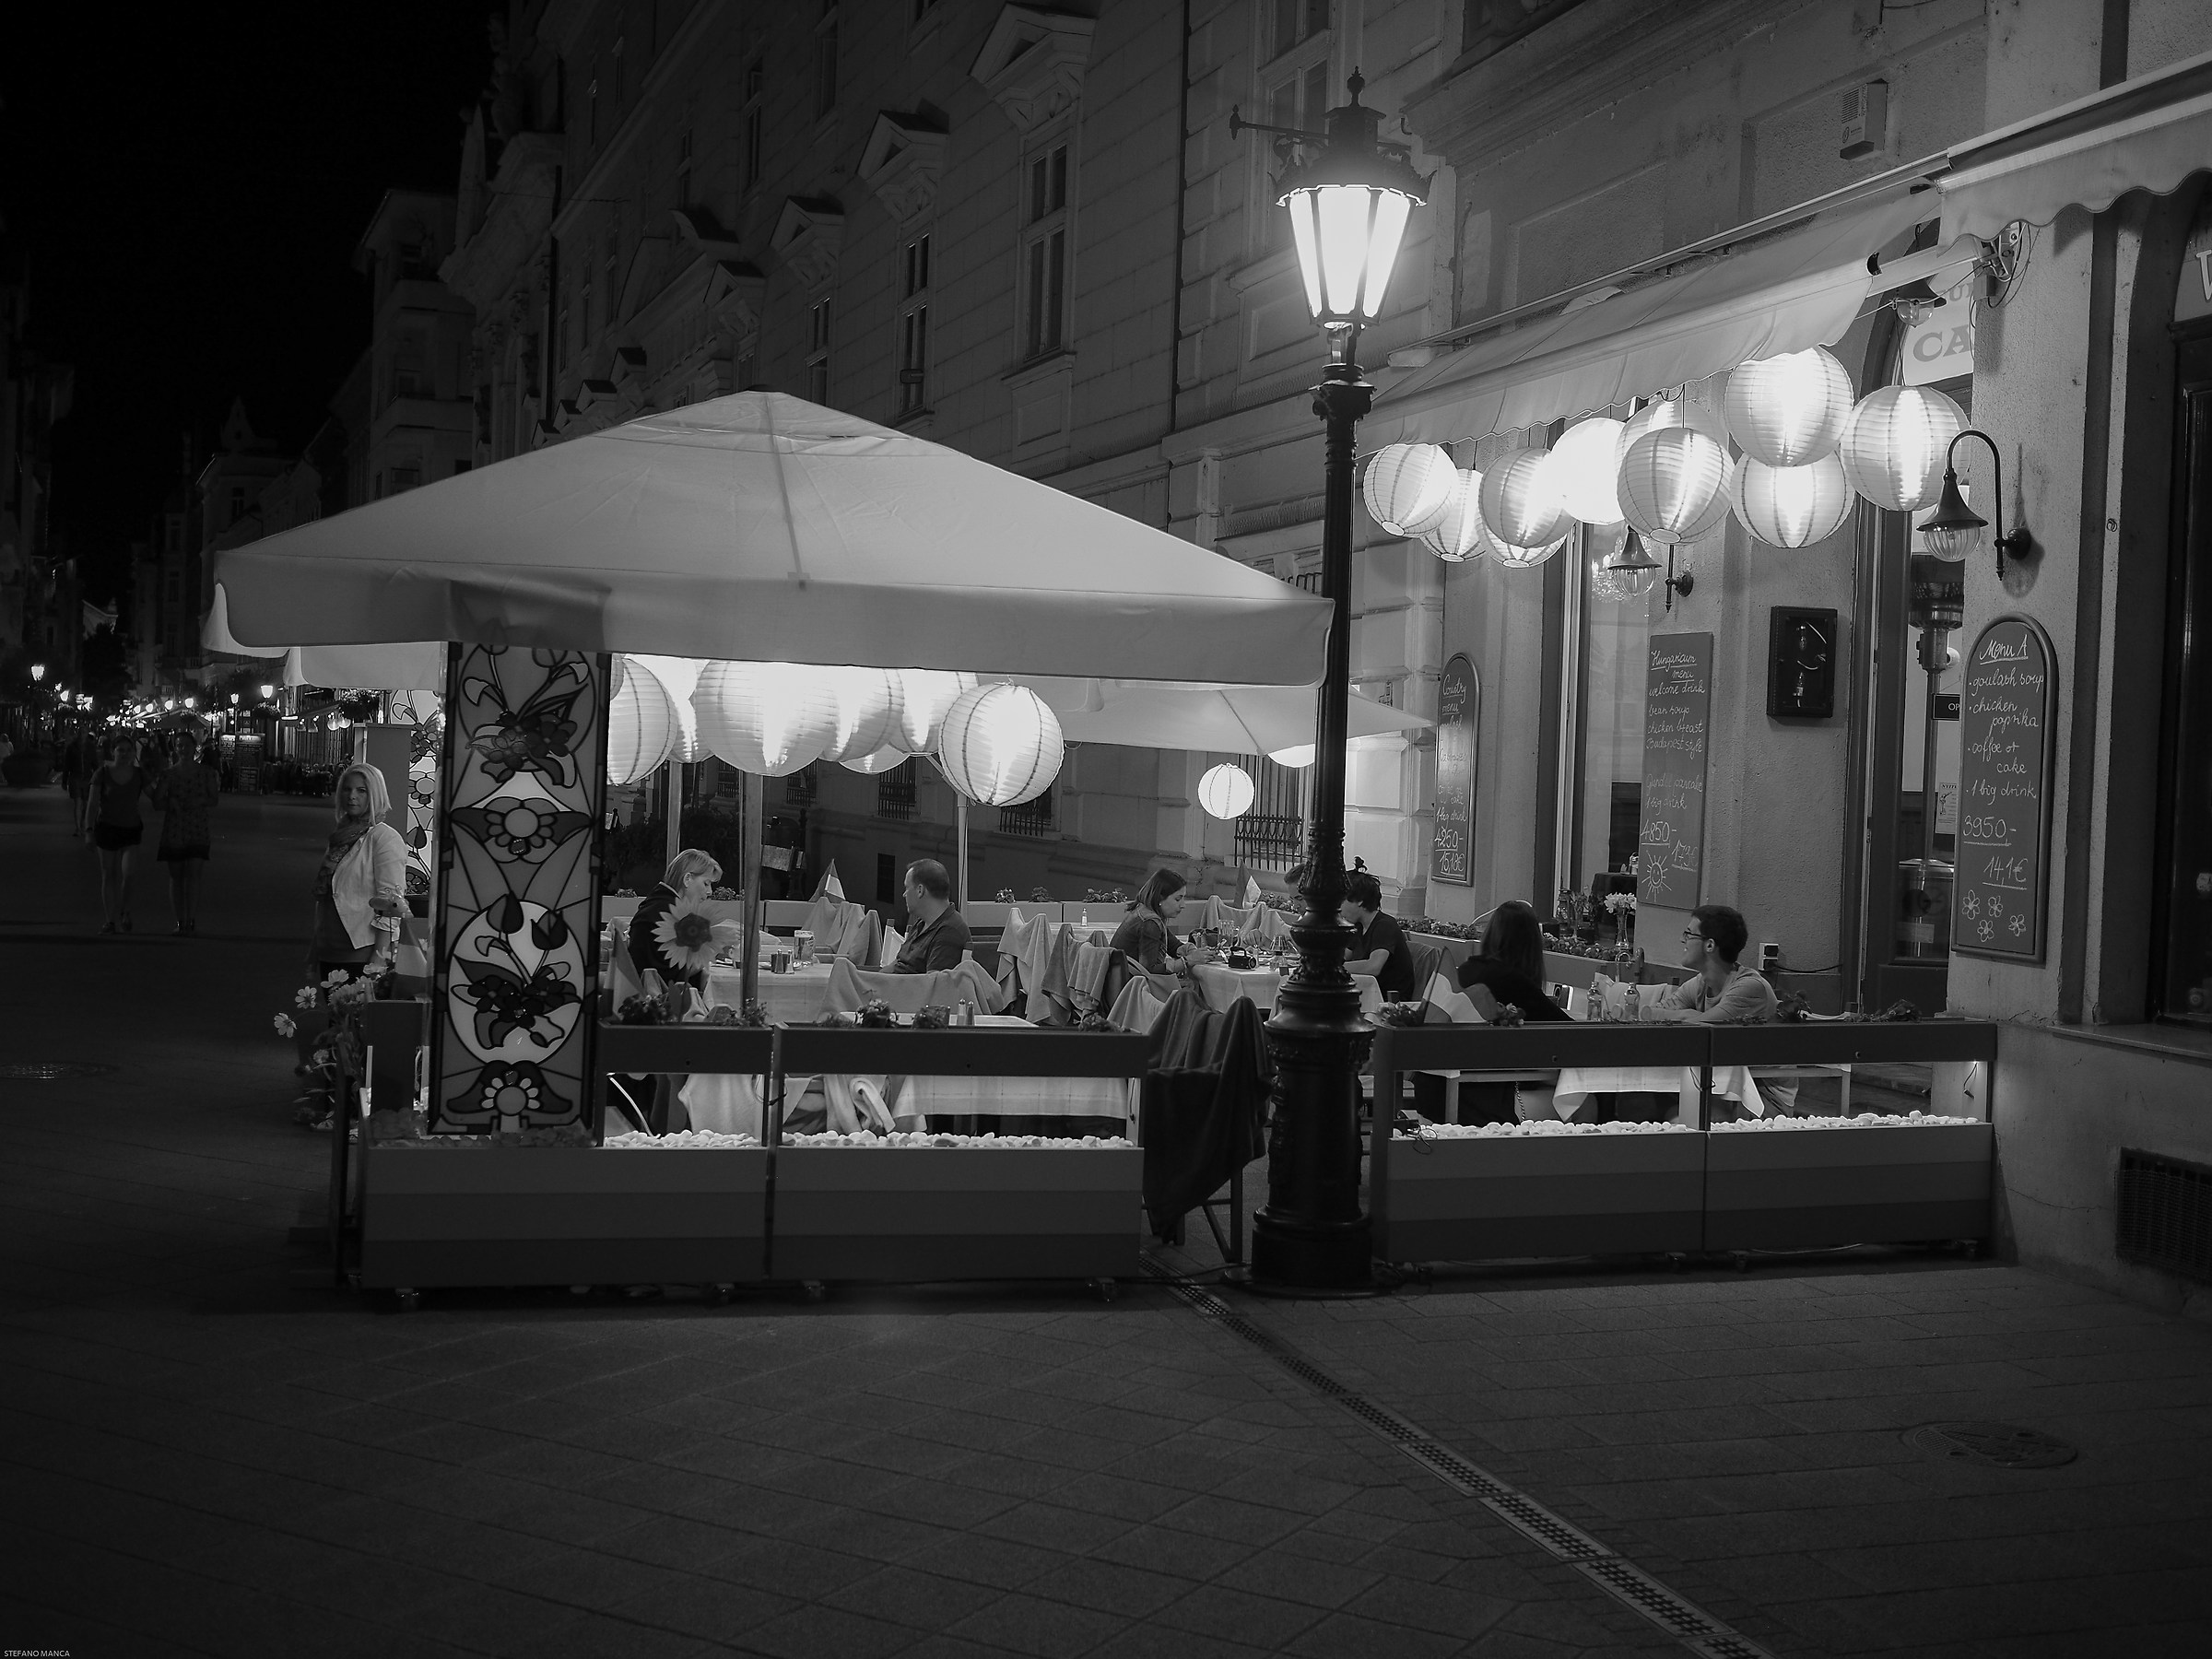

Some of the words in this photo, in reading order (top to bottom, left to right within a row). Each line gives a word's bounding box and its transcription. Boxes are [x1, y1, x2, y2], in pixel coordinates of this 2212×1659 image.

[1979, 639, 2015, 660] Menu
[1671, 669, 1694, 679] menu
[2020, 673, 2044, 693] soup
[1442, 673, 1467, 704] Country
[1648, 681, 1679, 697] welcome
[1649, 703, 1668, 717] bean
[1972, 696, 2018, 714] chicken
[1989, 708, 2039, 737] paprika
[1996, 757, 2027, 774] cake
[1980, 779, 1997, 806] big
[2000, 780, 2037, 799] drink
